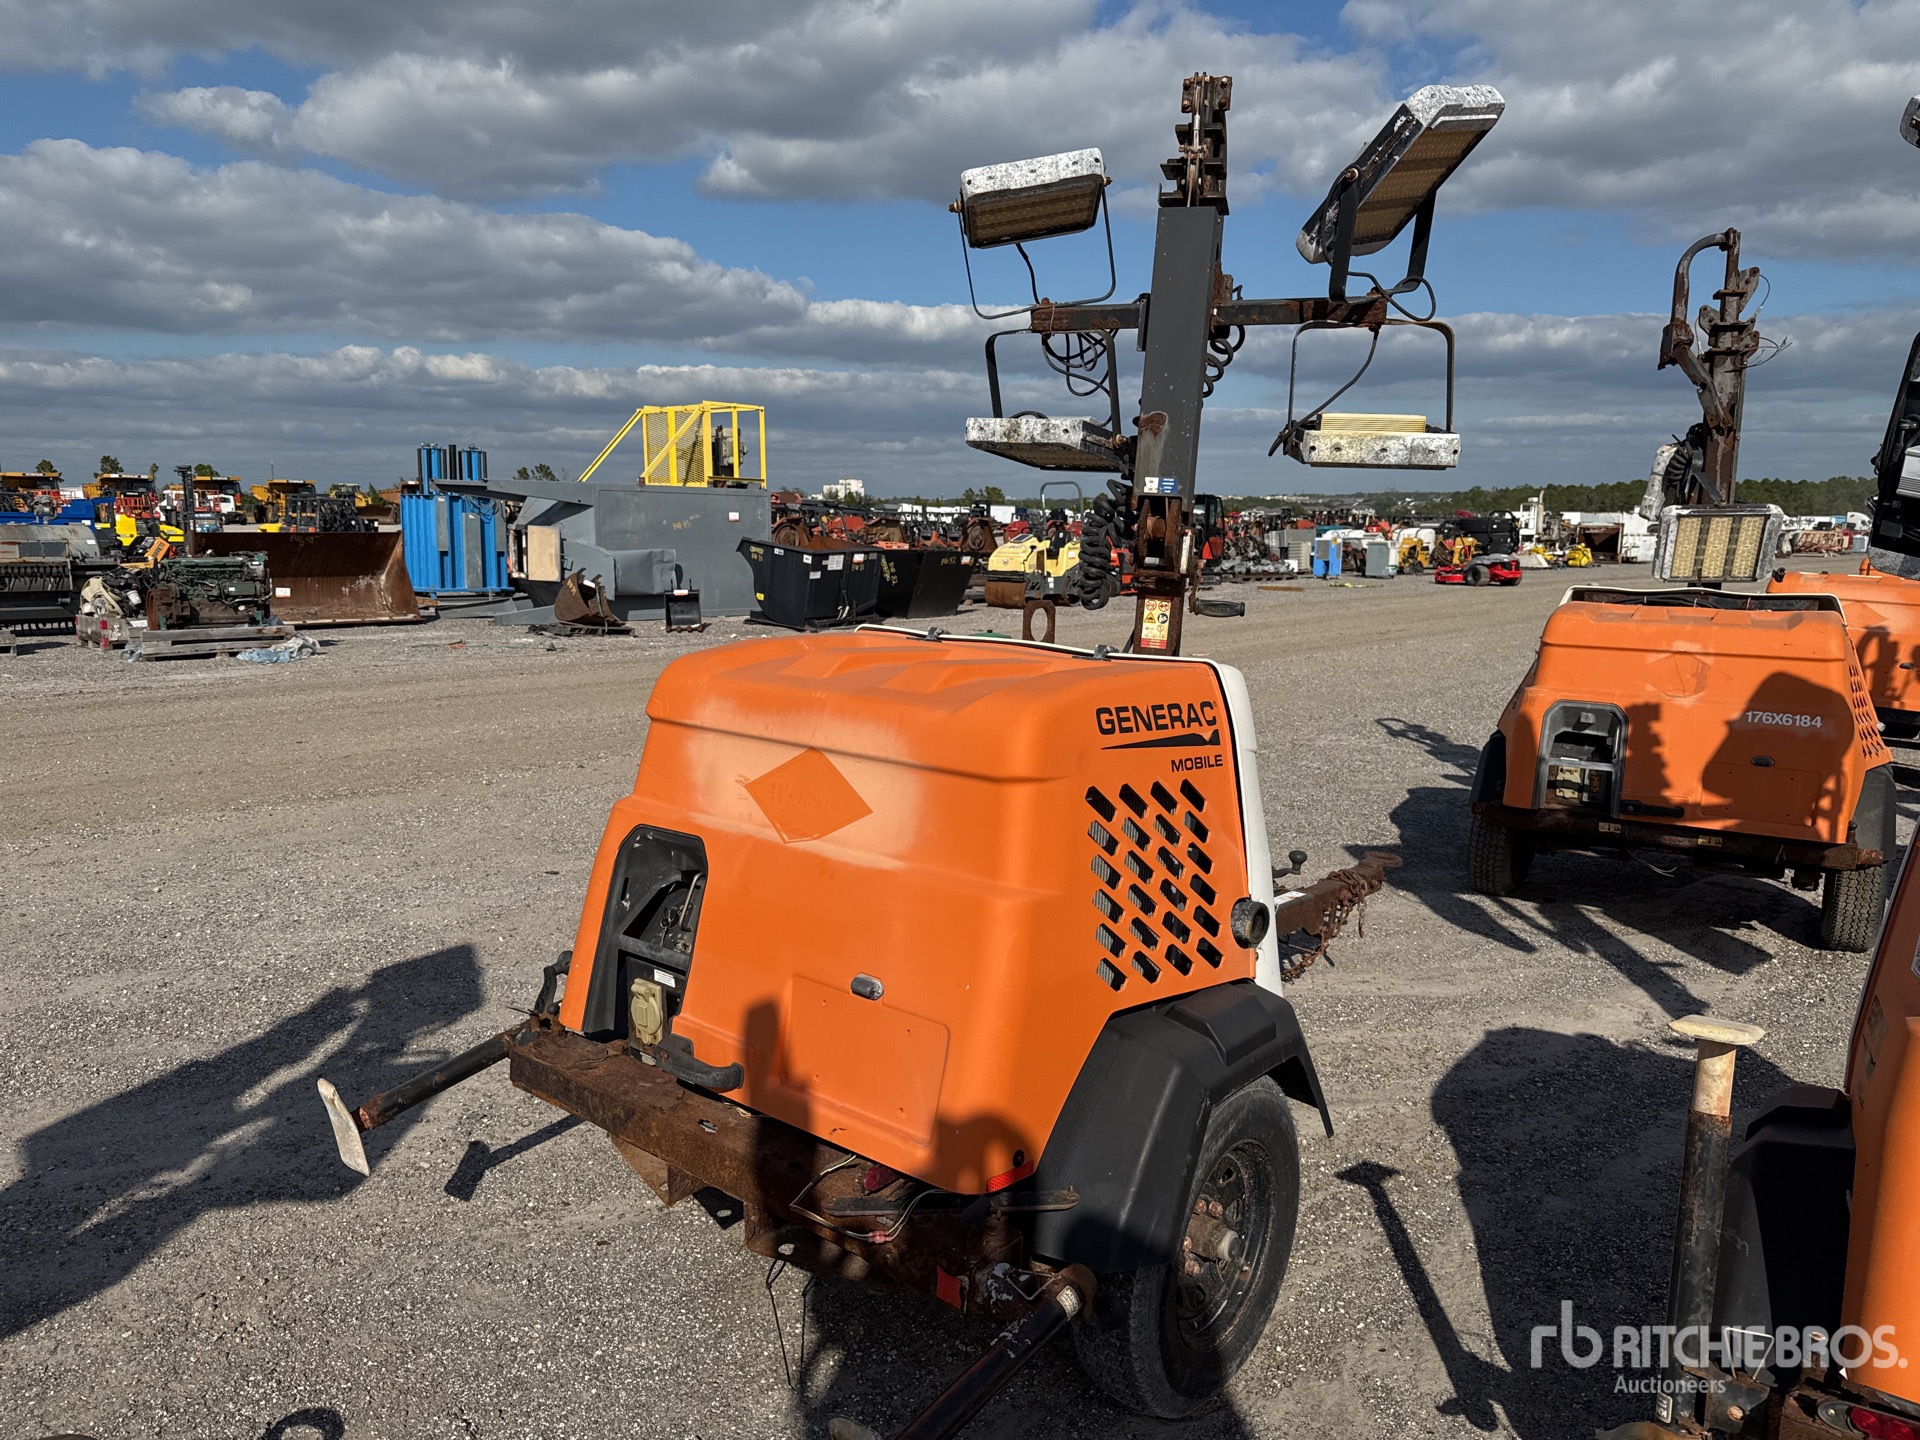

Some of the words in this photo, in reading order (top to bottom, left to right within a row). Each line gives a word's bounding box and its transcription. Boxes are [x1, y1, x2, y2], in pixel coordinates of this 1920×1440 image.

[1095, 700, 1217, 736] GENERAC
[1745, 711, 1822, 728] 176X6184
[1170, 754, 1224, 773] MOBILE
